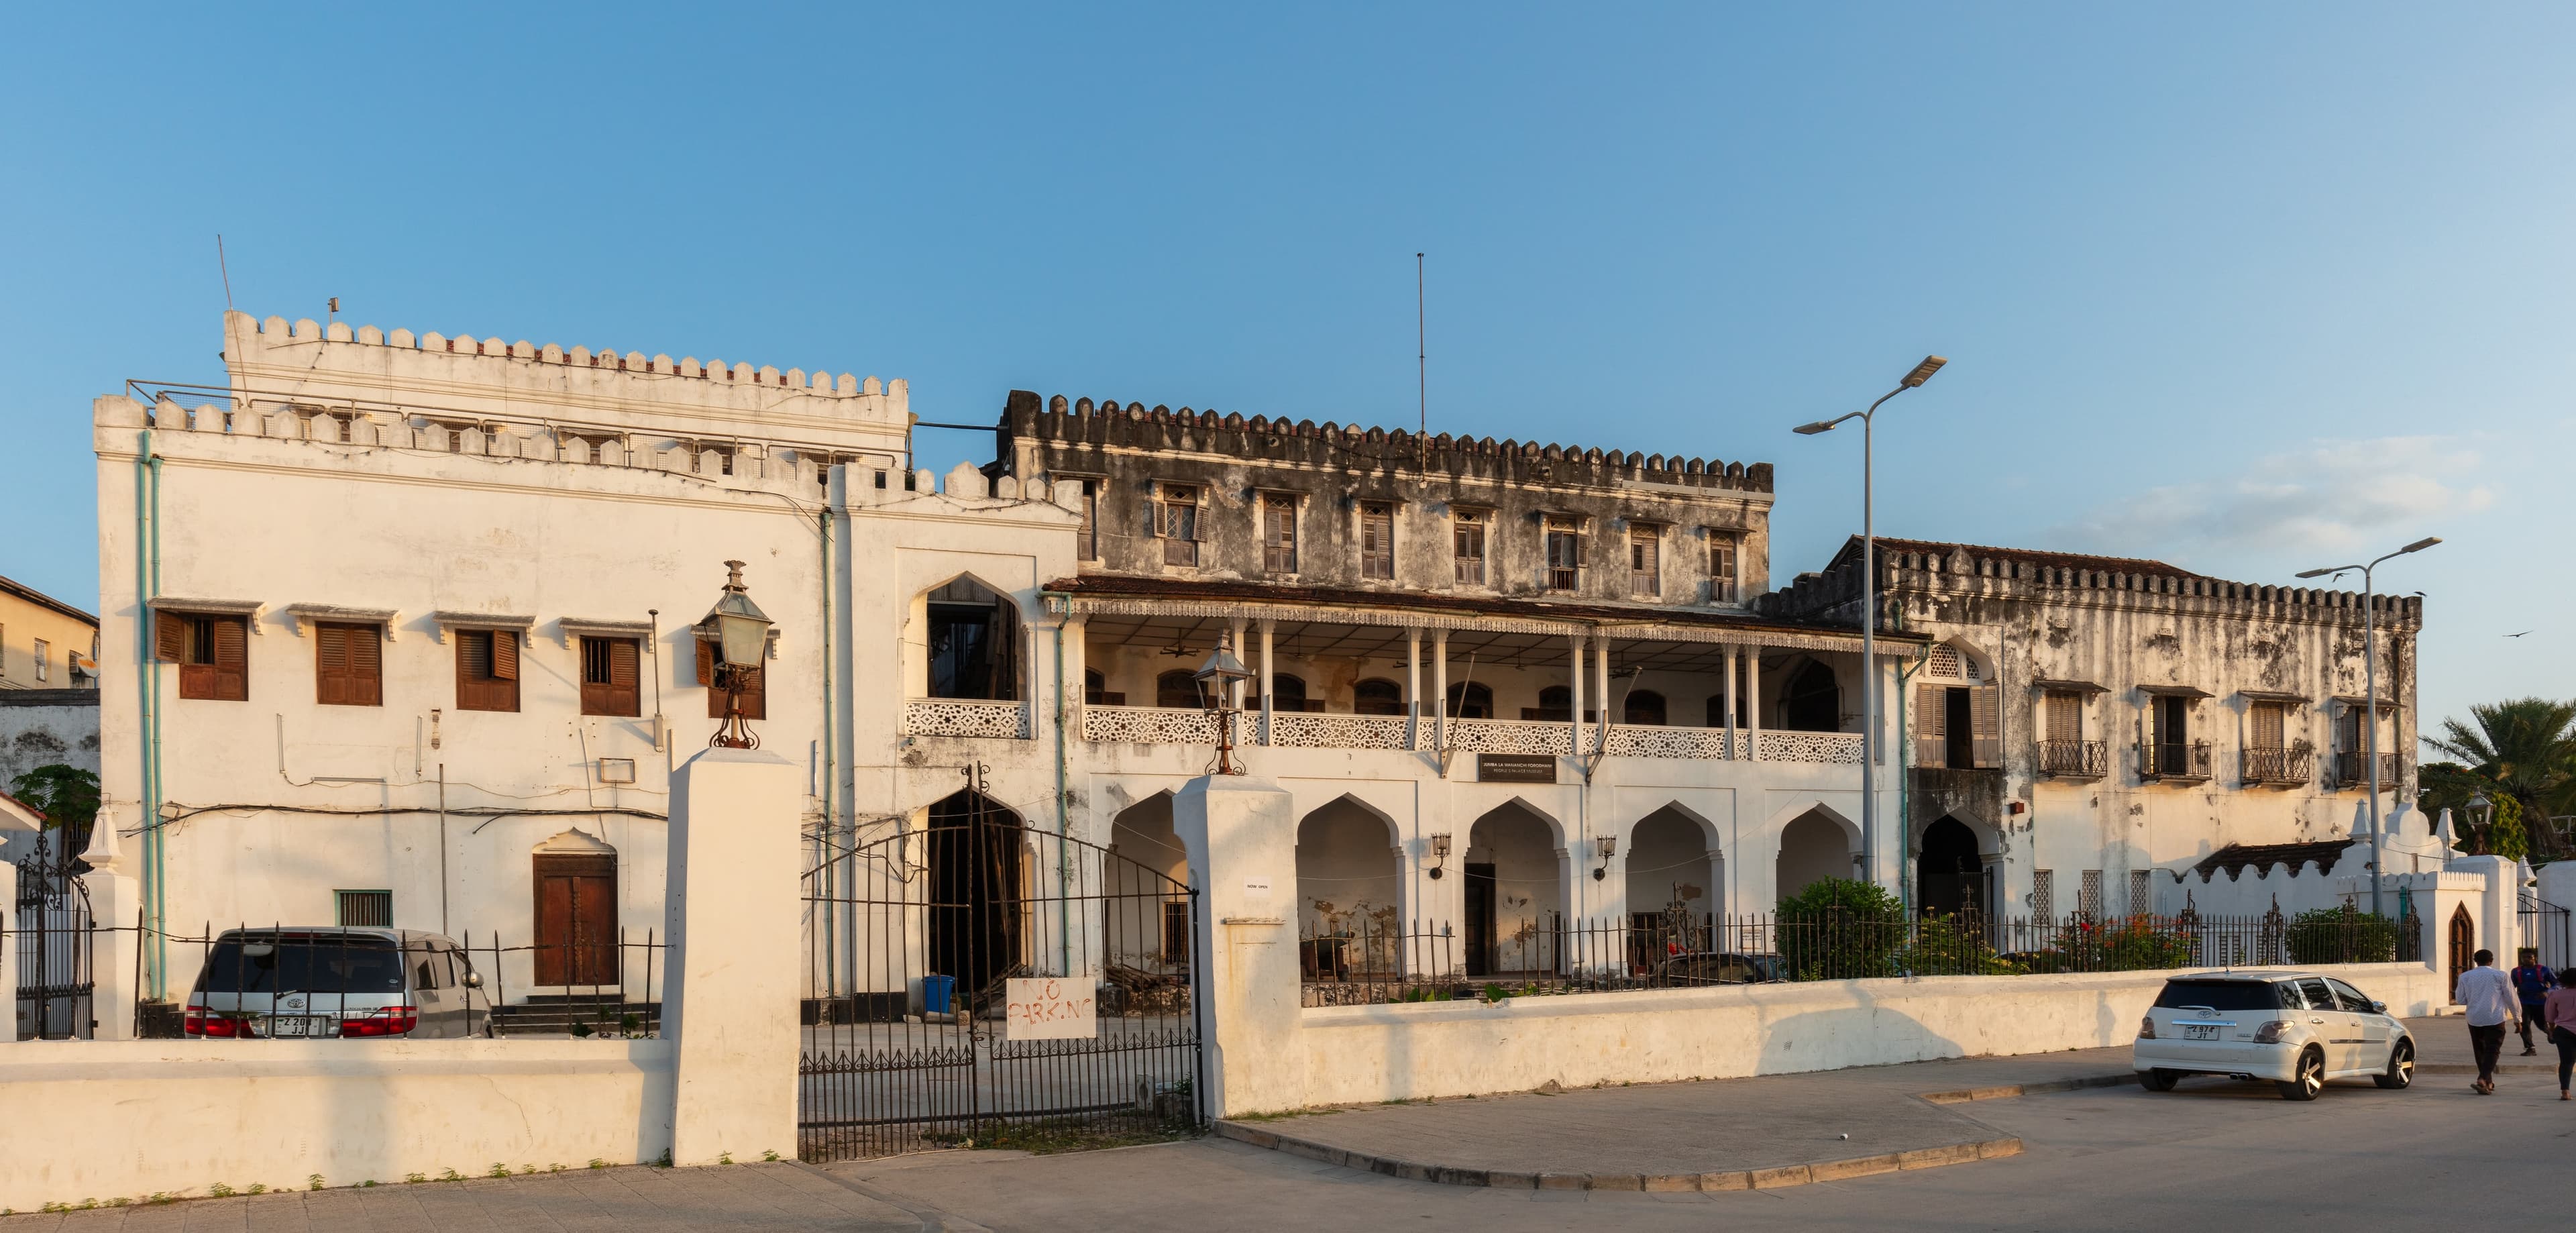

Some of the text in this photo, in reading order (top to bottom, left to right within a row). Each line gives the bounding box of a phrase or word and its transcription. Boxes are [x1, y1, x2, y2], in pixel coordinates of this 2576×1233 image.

[1022, 979, 1061, 1000] NO
[284, 1018, 290, 1026] Z
[1008, 998, 1091, 1026] PARKING
